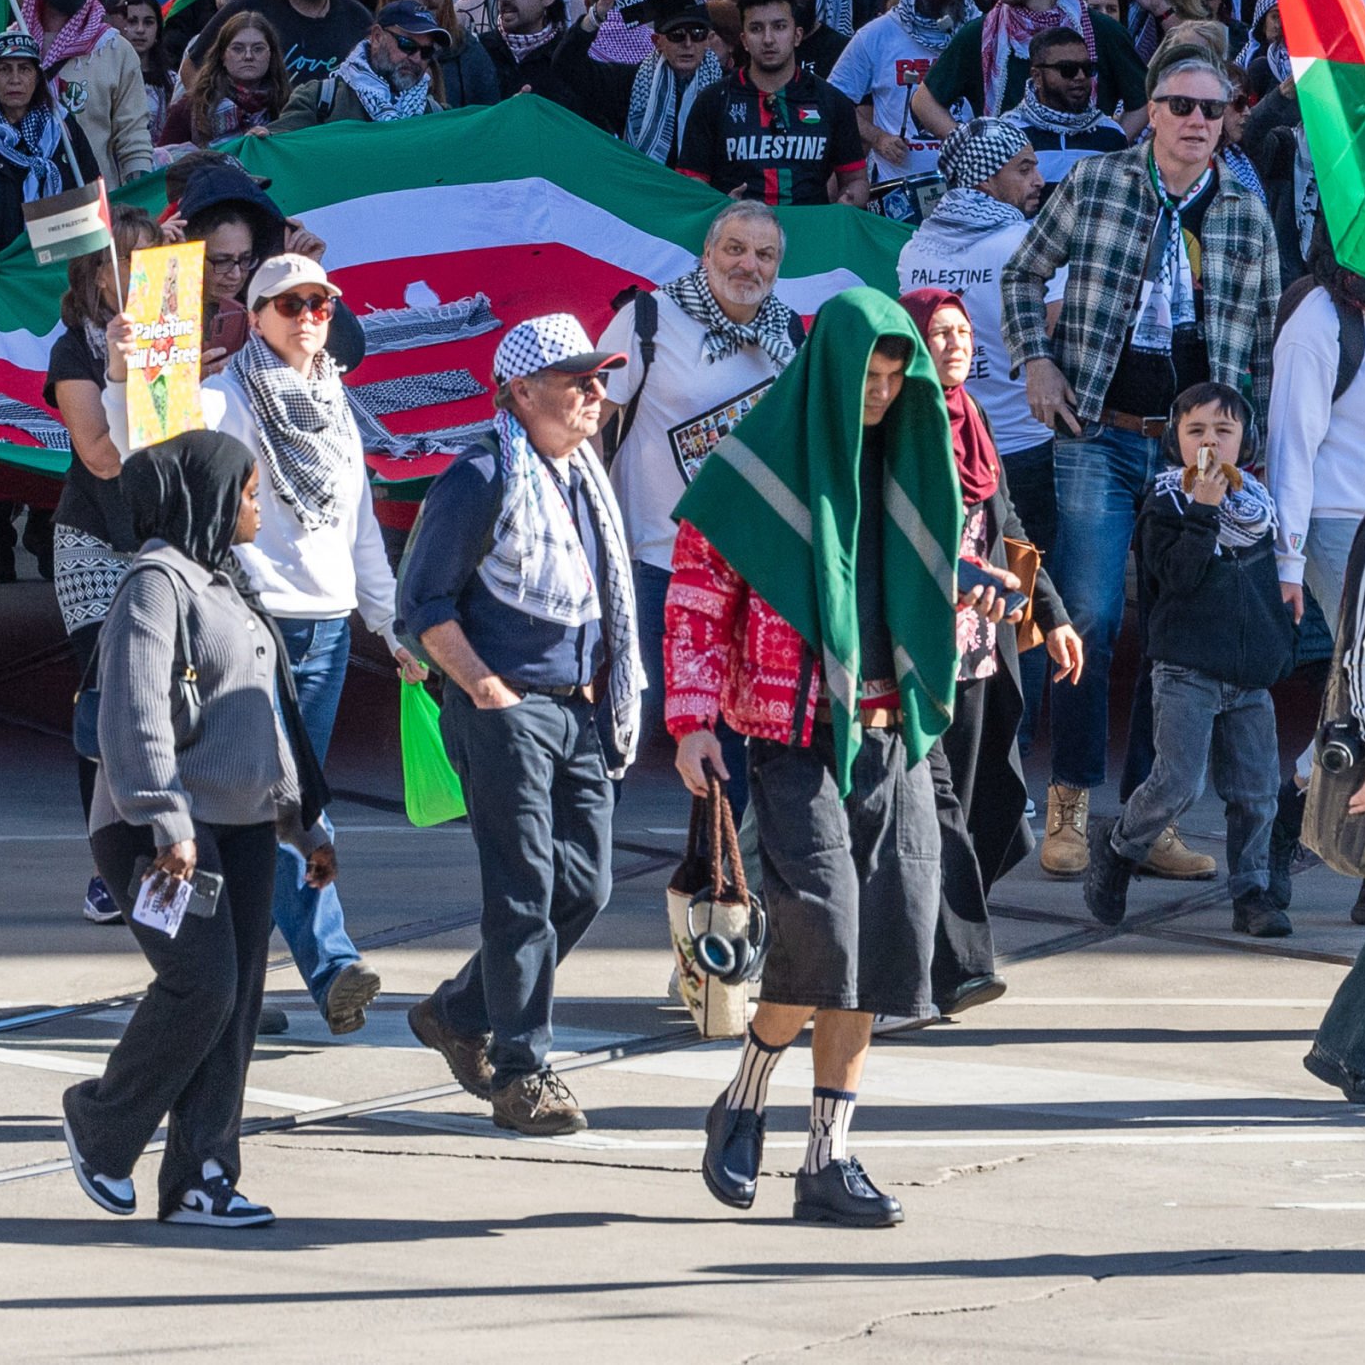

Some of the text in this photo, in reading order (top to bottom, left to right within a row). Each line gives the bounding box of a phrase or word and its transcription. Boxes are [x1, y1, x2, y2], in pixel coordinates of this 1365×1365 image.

[726, 136, 827, 162] PALESTINE
[48, 225, 61, 233] FREE
[911, 268, 993, 284] PALESTINE
[135, 318, 195, 341] Palestine
[150, 345, 200, 367] be Free
